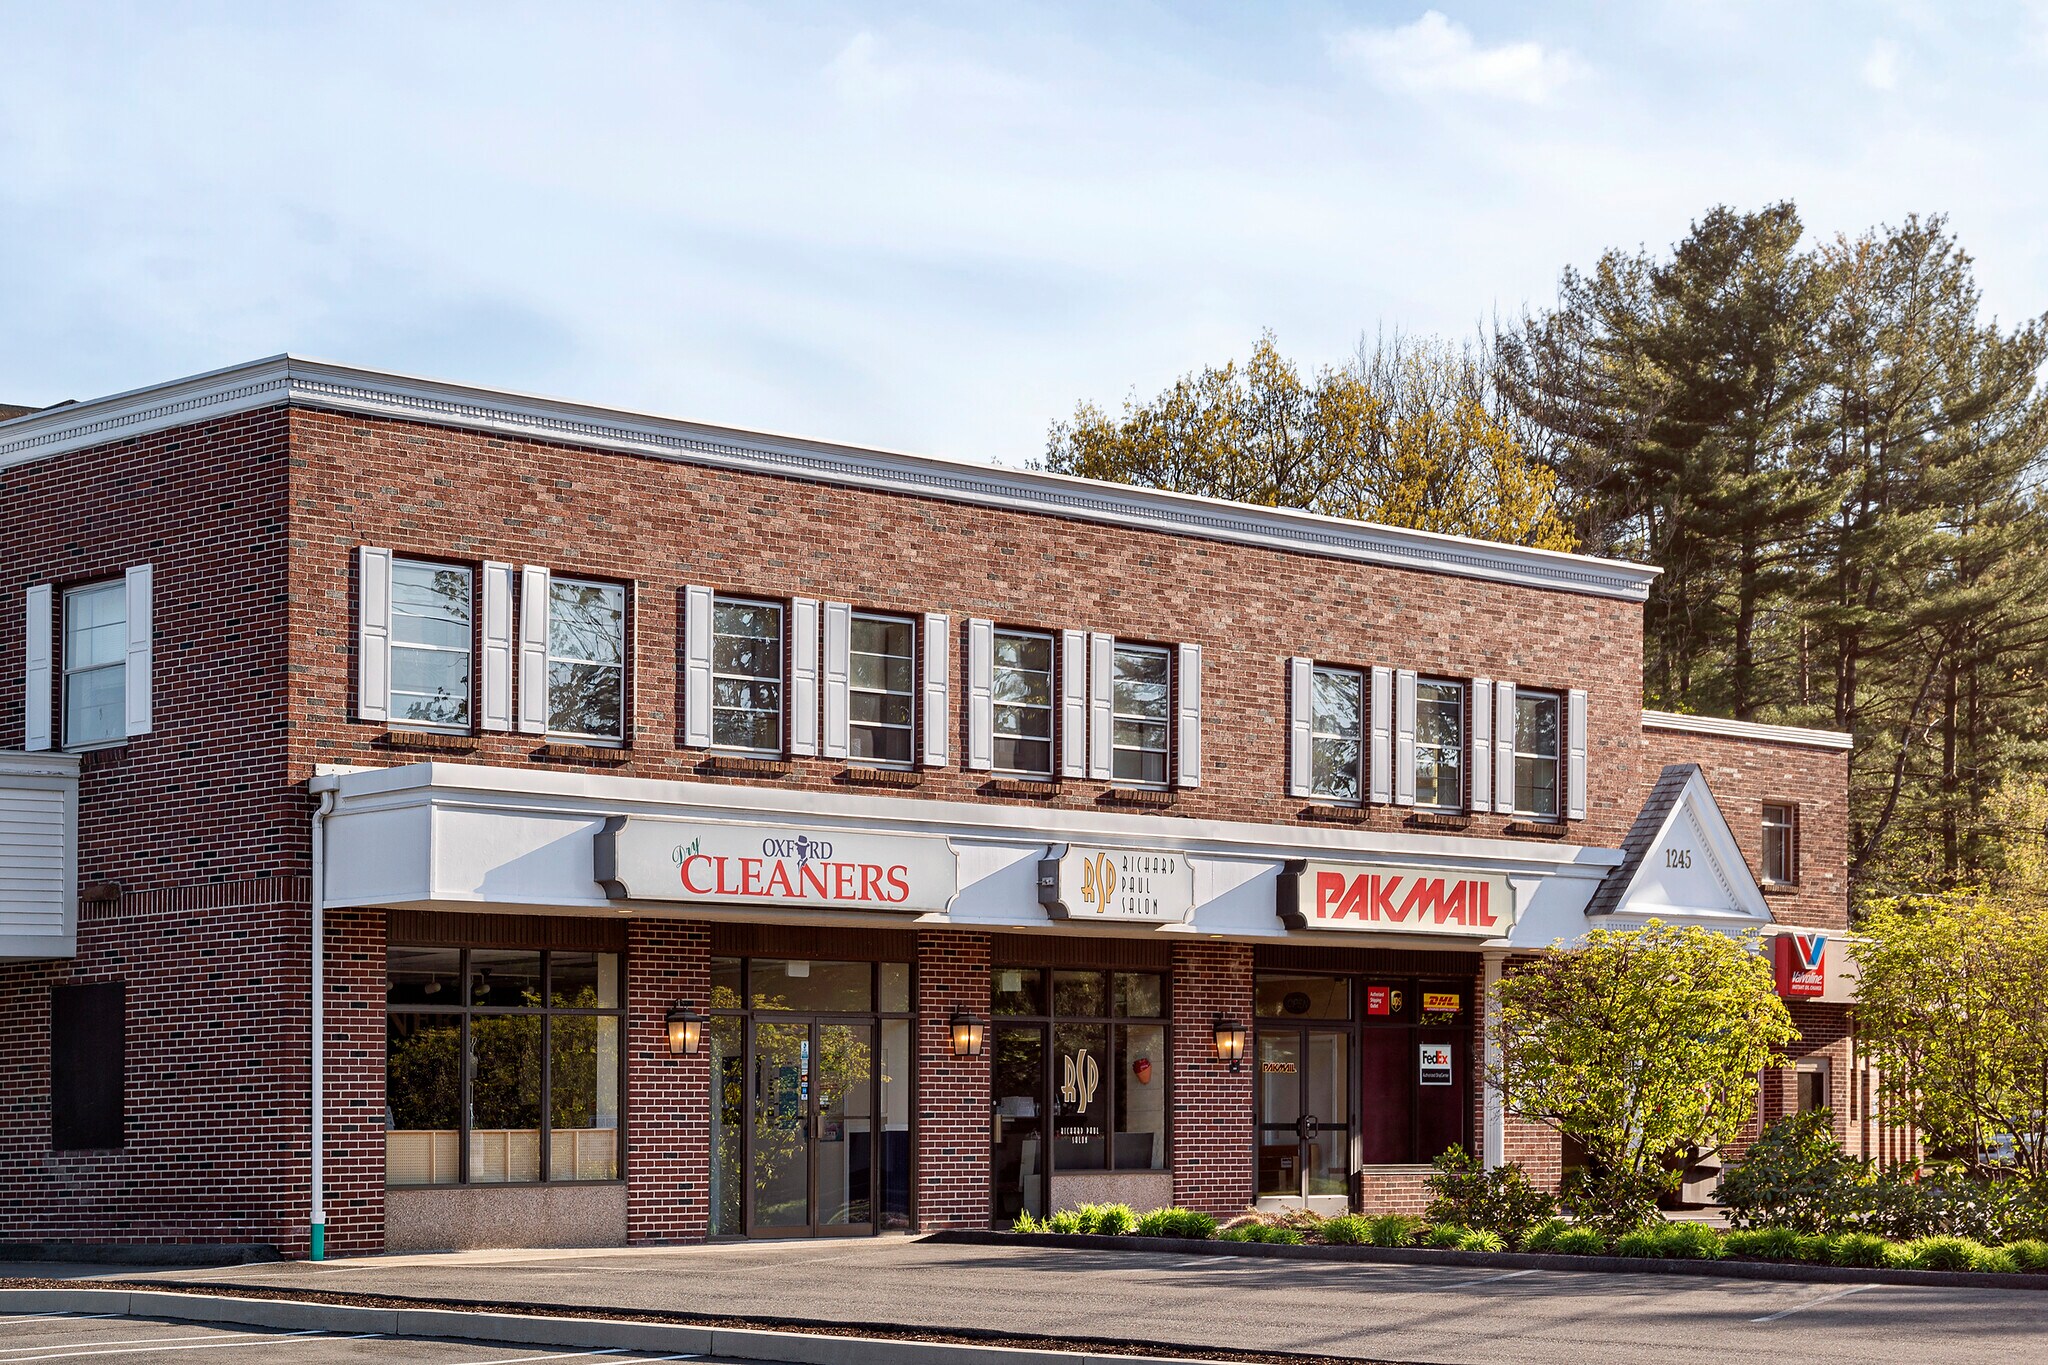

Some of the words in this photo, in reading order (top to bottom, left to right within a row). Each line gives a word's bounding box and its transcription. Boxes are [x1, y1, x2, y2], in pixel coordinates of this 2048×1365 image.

[672, 835, 701, 868] Dry
[762, 836, 833, 860] OXFRD
[1122, 855, 1175, 875] RICHARD
[1666, 848, 1692, 869] 1245
[681, 854, 909, 903] CLEANERS
[1081, 852, 1117, 914] RSP
[1122, 876, 1150, 894] PAUL
[1122, 897, 1158, 915] SALON
[1316, 871, 1498, 927] PAKMAIL
[1792, 971, 1823, 984] Valvoline
[1428, 996, 1455, 1006] DHL
[1262, 1062, 1298, 1073] PAKMAIL
[1422, 1050, 1448, 1065] FedEx
[1060, 1048, 1099, 1114] RSP
